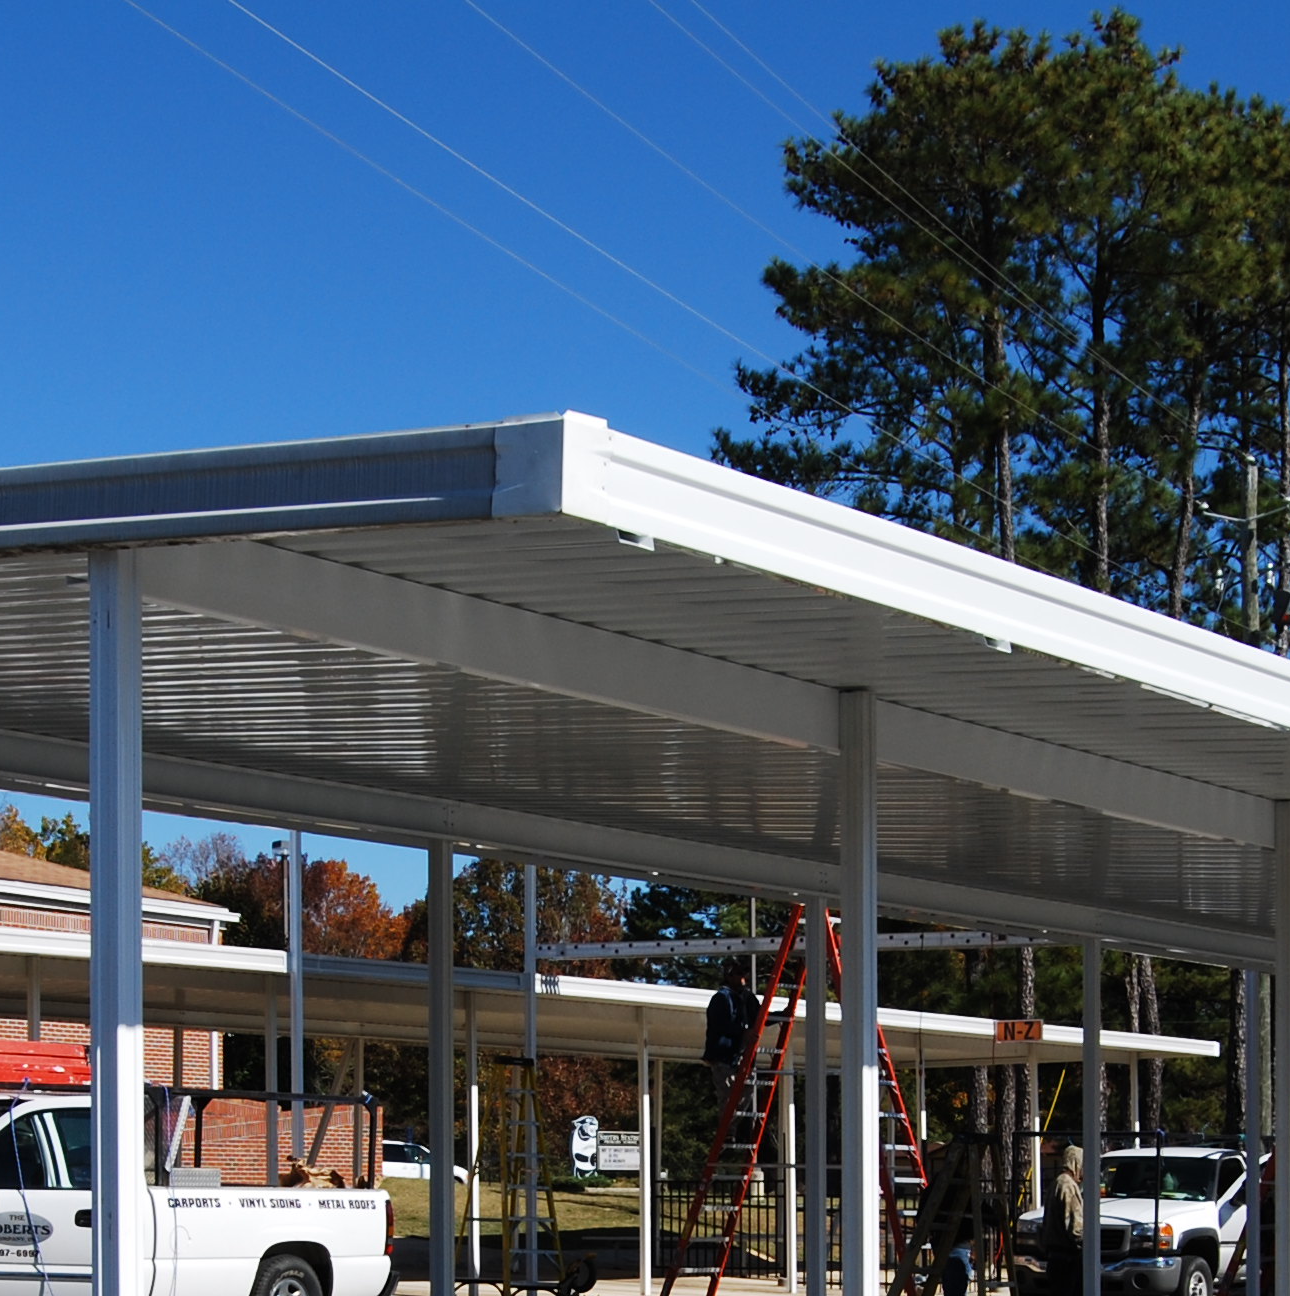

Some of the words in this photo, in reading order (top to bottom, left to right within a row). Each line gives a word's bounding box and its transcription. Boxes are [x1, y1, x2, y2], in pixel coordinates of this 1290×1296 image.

[1003, 1021, 1035, 1040] N-Z
[167, 1197, 221, 1208] CARPORTS
[238, 1198, 267, 1208] VINYL
[270, 1198, 302, 1209] SIDING
[318, 1199, 346, 1209] METAL
[348, 1199, 377, 1209] ROOFS
